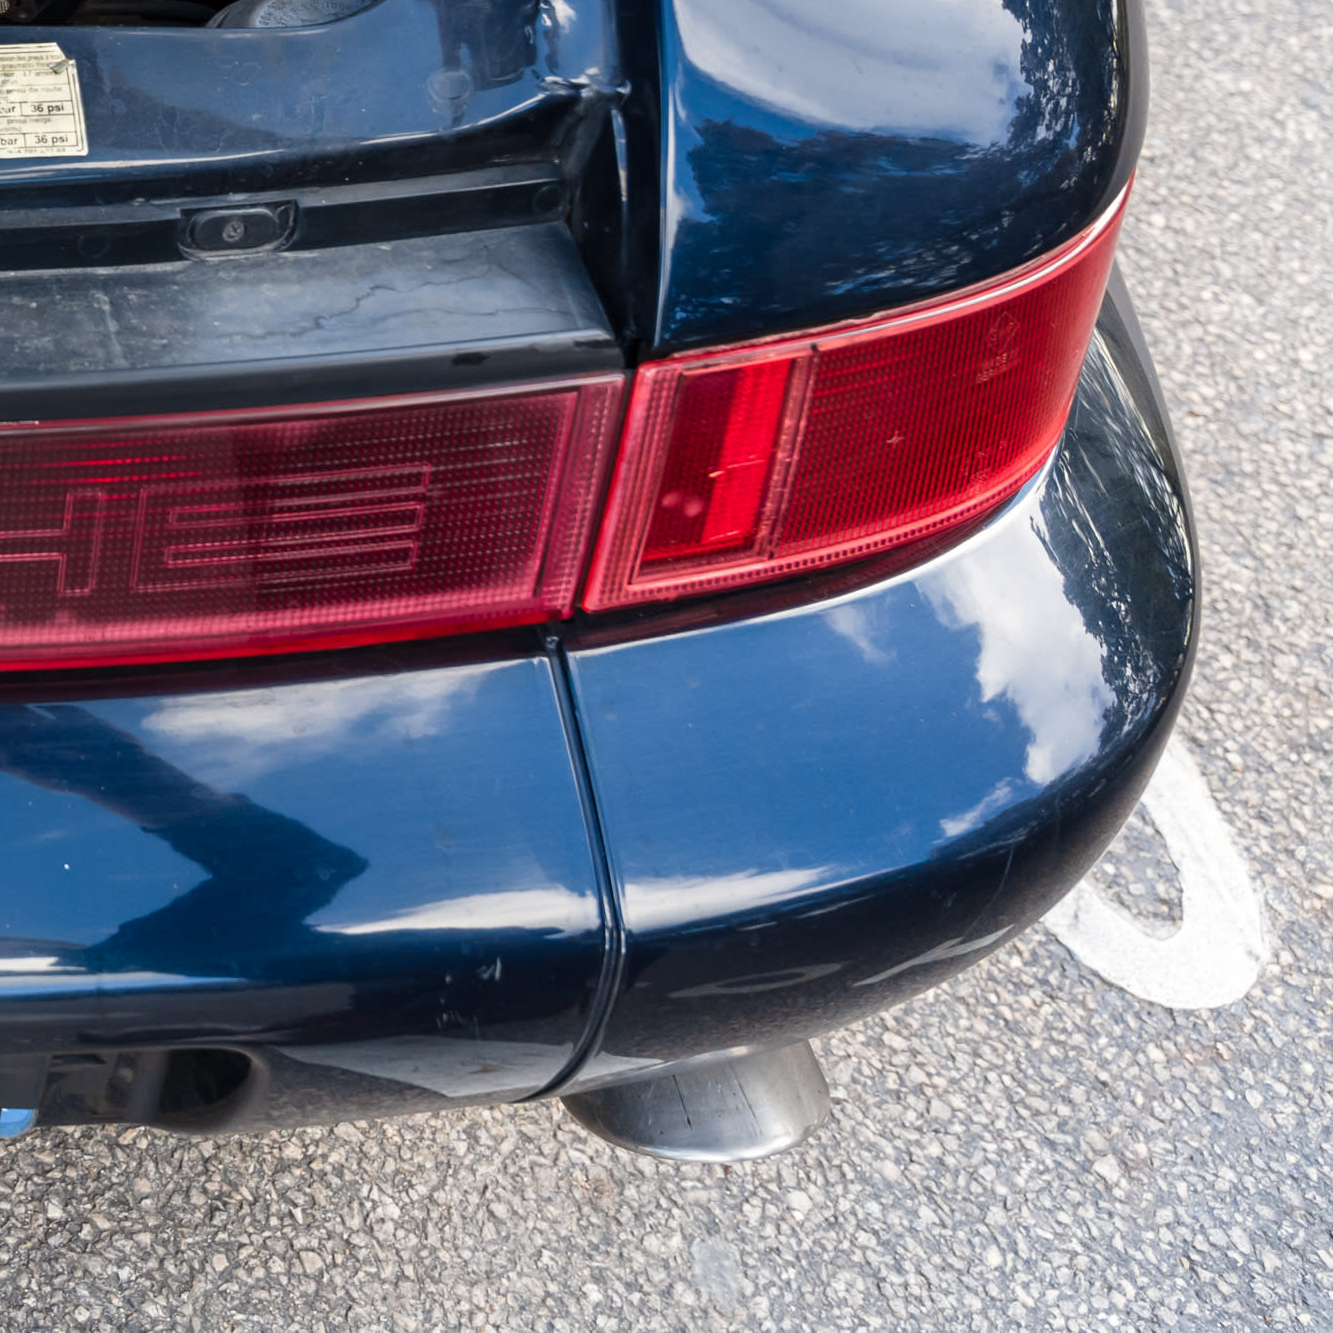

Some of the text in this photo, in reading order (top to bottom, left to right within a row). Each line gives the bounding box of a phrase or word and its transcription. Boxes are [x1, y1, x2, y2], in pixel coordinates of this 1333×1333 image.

[31, 102, 64, 115] 36 psi
[0, 136, 18, 145] bar
[34, 134, 68, 147] 36 psi
